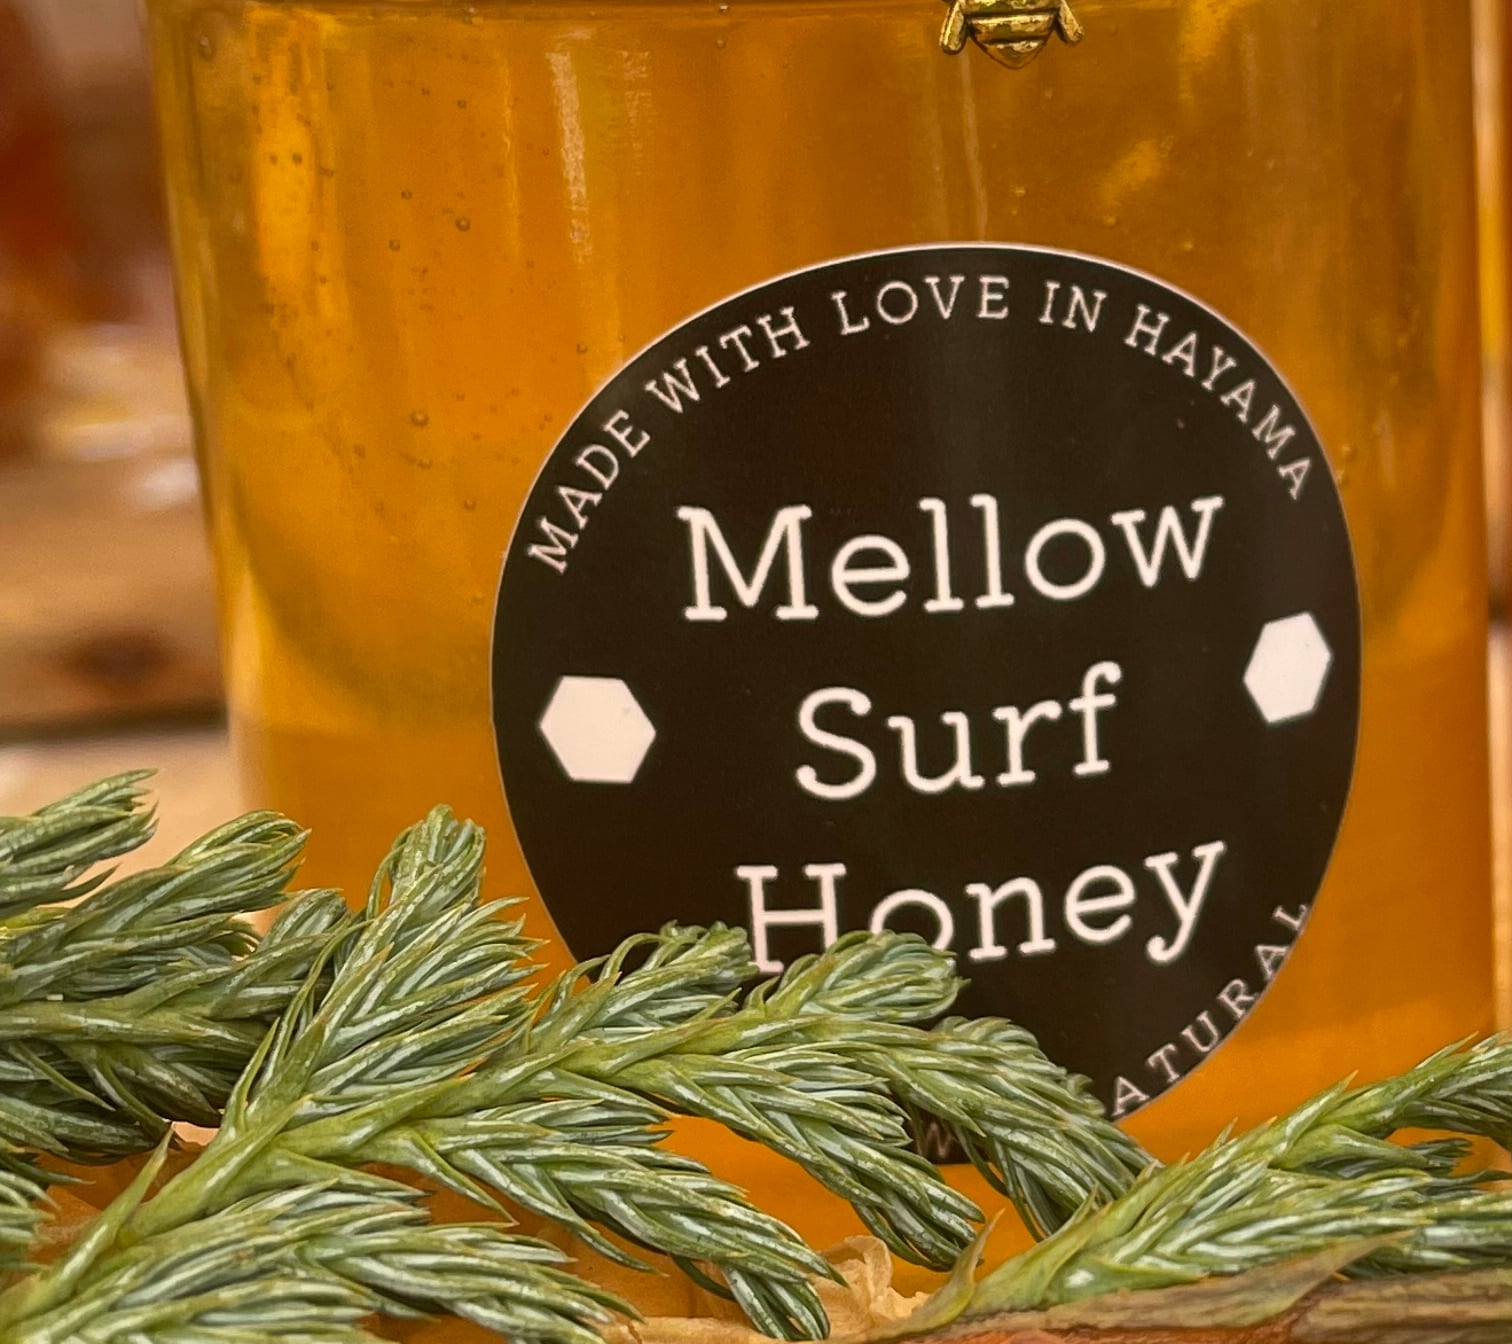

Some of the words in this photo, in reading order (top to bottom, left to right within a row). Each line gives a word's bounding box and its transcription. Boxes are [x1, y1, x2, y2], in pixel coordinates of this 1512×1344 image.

[527, 410, 651, 574] MADE
[645, 306, 810, 416] WITH
[832, 275, 1011, 332] LOVE
[1039, 280, 1108, 333] IN
[1125, 303, 1313, 501] HAYAMA
[676, 494, 1225, 622] Mellow
[796, 660, 1123, 800] Surf
[1109, 900, 1309, 1117] ATURAL
